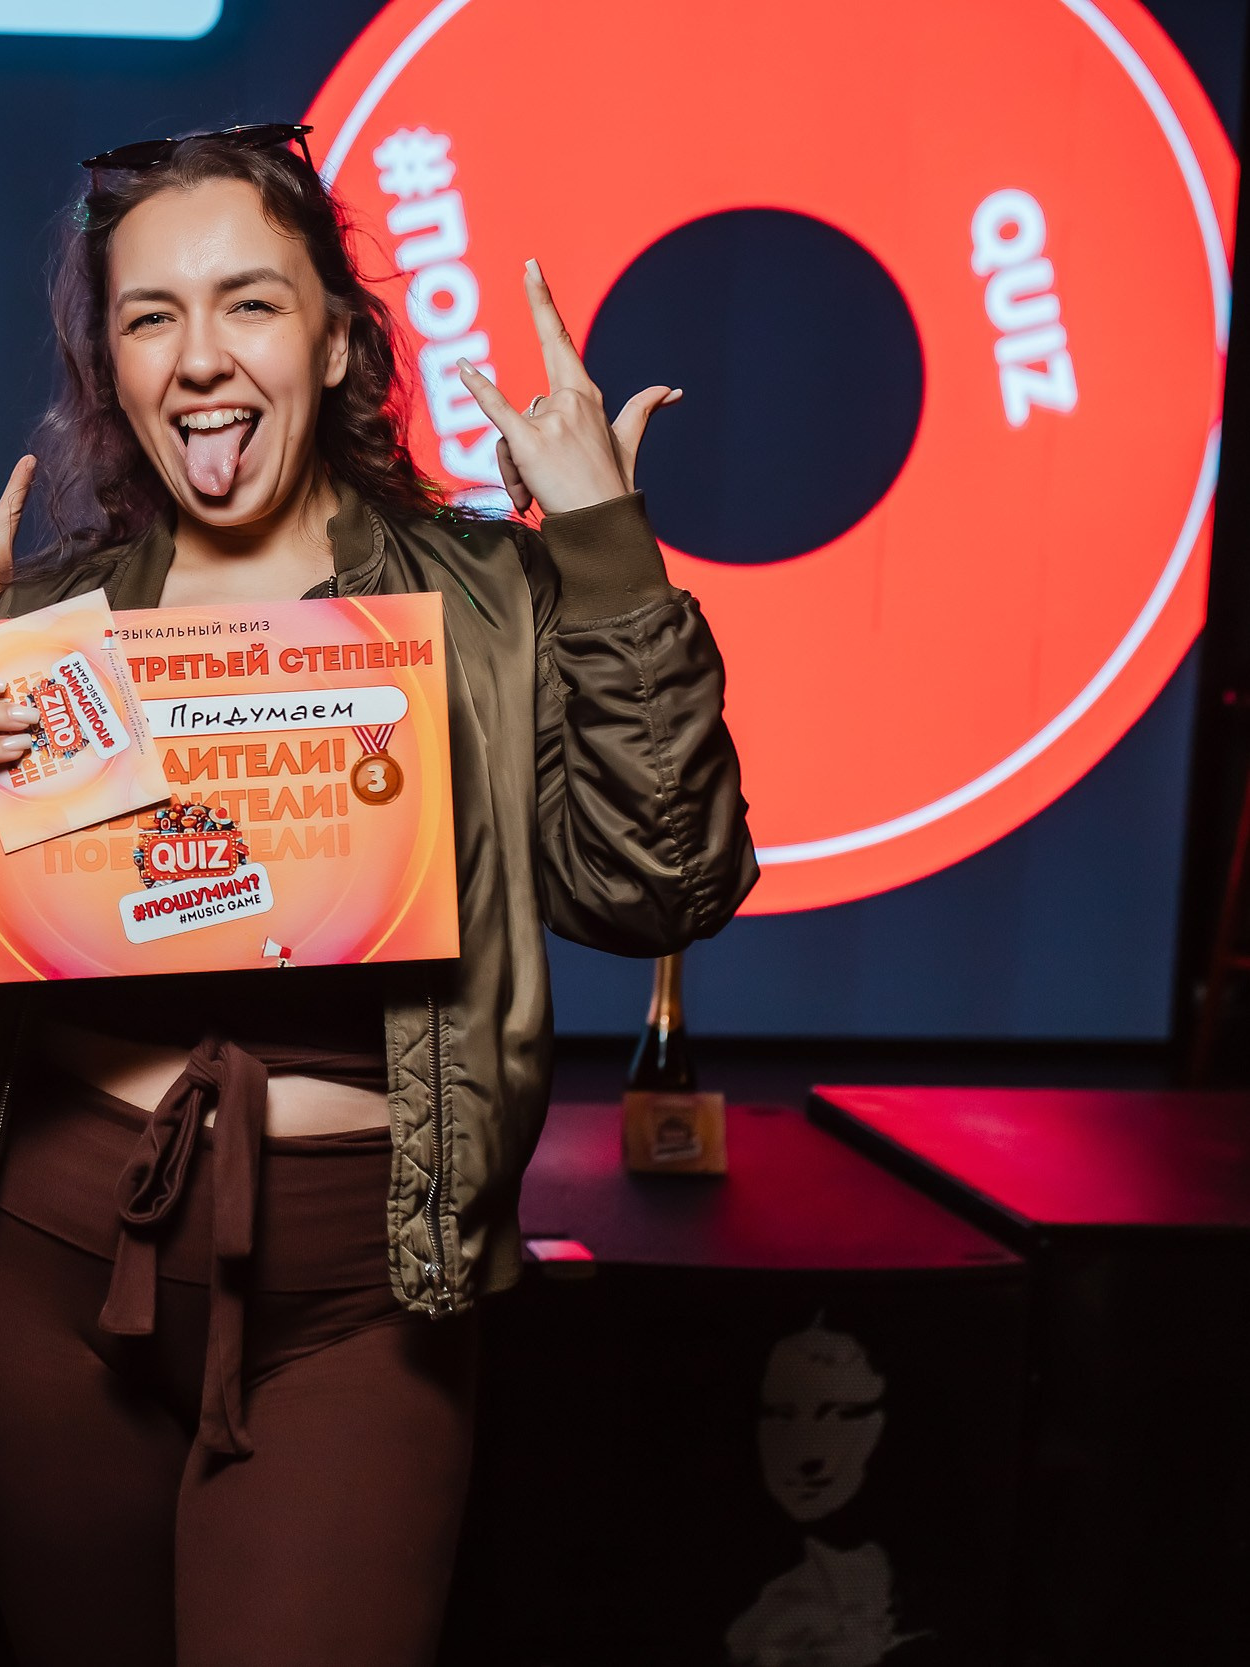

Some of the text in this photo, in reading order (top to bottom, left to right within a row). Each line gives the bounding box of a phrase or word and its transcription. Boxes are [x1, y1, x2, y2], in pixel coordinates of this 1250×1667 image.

[969, 188, 1079, 428] QUIZ
[114, 620, 271, 641] ЗЫКАЛЬНЫЙ КВИЗ
[126, 639, 433, 683] ТРЕТЬЕЙ СТЕПЕНИ
[72, 660, 108, 716] #MUSIC GAME
[44, 688, 76, 747] QUIZ
[162, 738, 346, 785] ДИТЕЛИ!
[366, 763, 387, 793] 3
[151, 839, 230, 873] QUIZ
[133, 873, 260, 922] #ПОШУМИМ?
[179, 893, 262, 924] #MUSIC GAME
